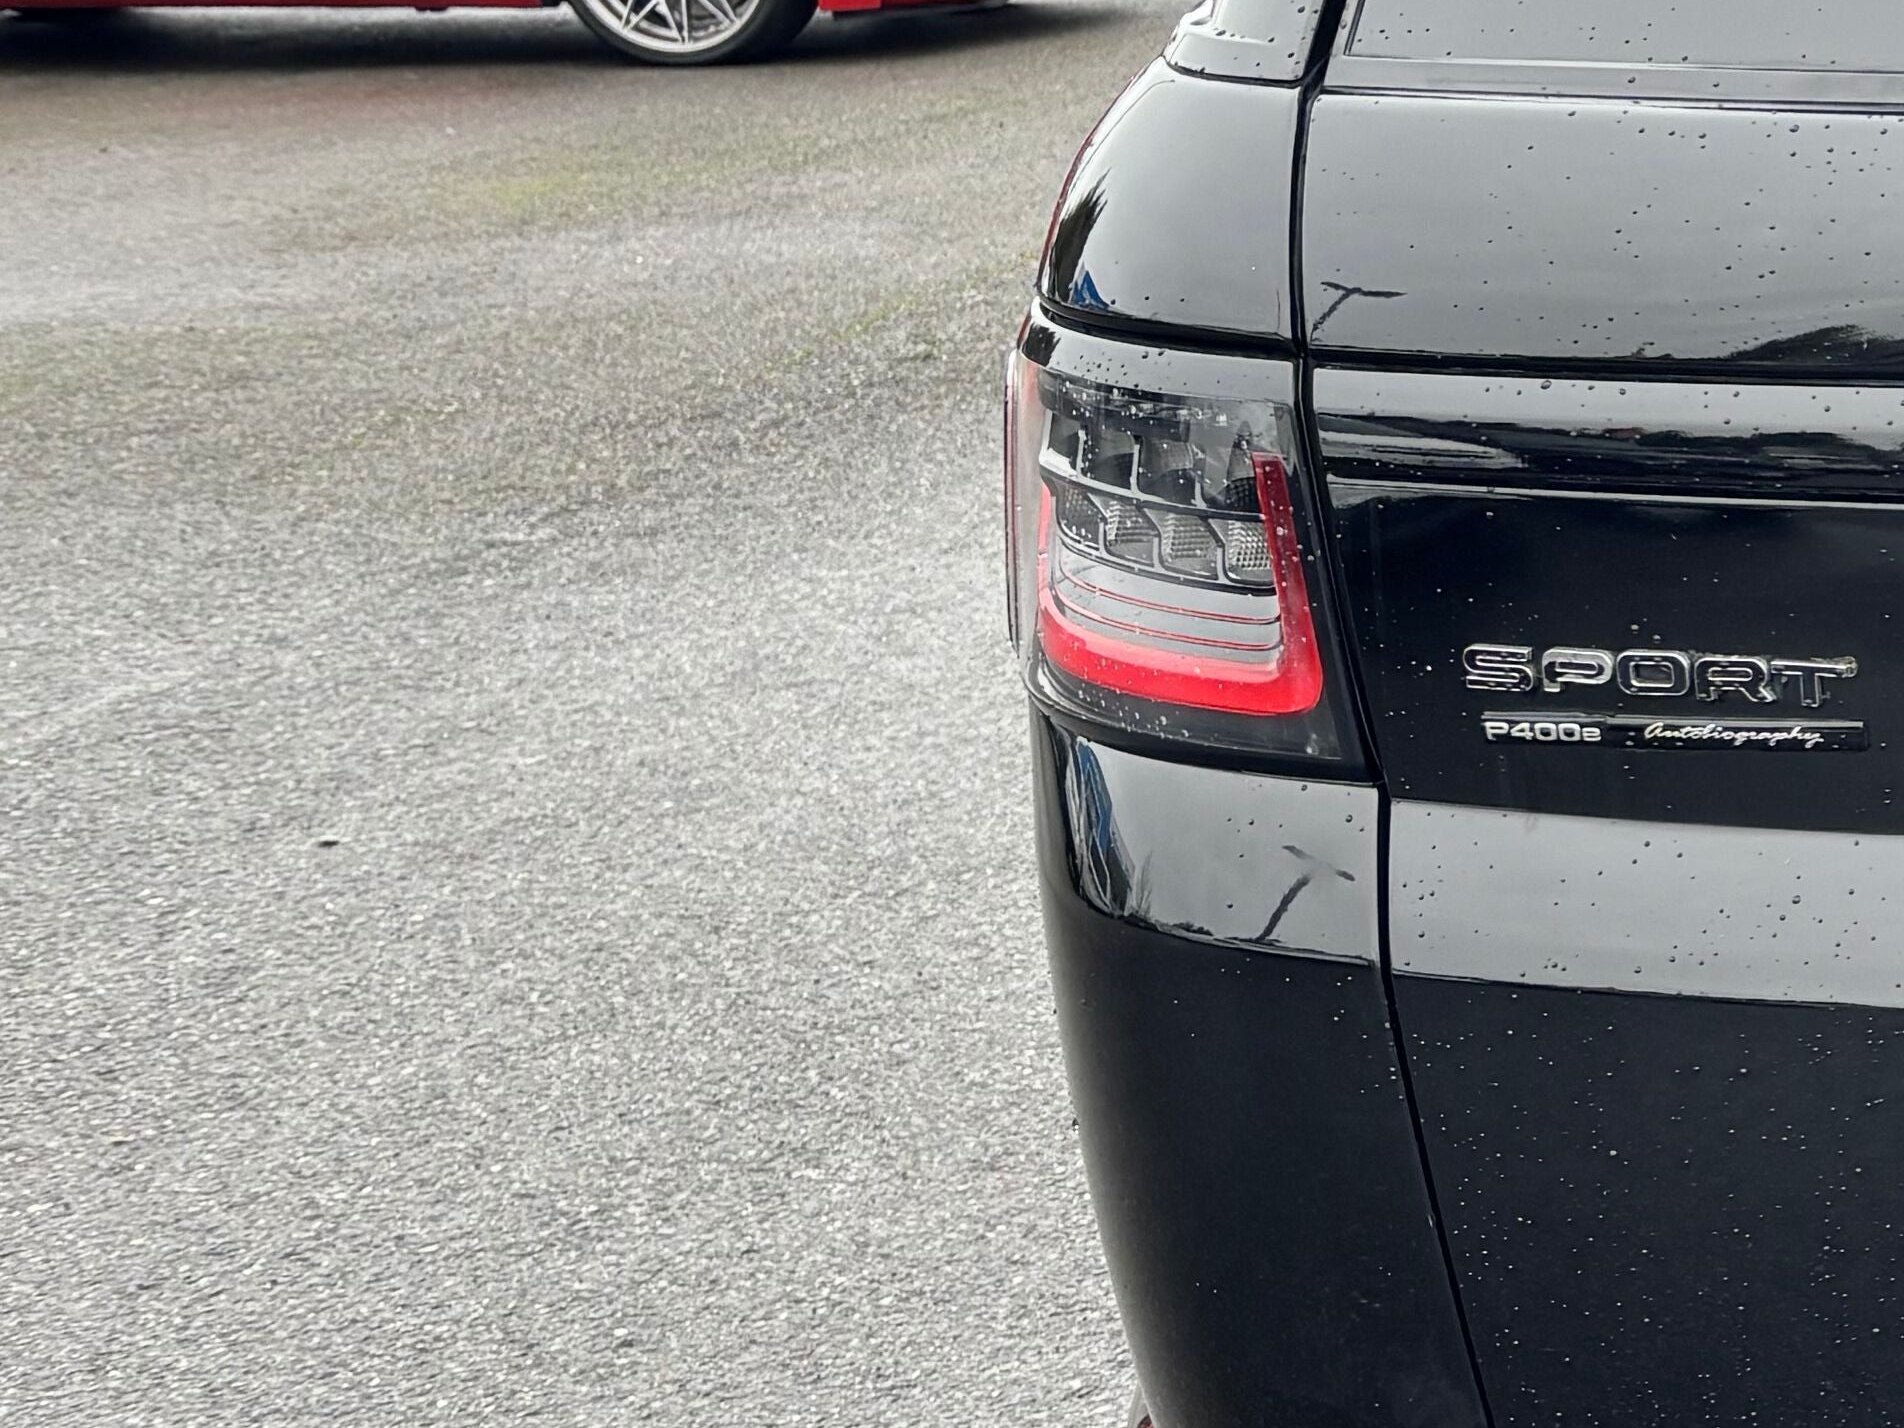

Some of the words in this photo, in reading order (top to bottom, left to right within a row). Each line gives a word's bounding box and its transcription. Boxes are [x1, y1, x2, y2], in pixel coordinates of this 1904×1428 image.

[1462, 642, 1858, 708] SPORT
[1484, 721, 1602, 743] P400e
[1644, 720, 1825, 749] Autobiography
